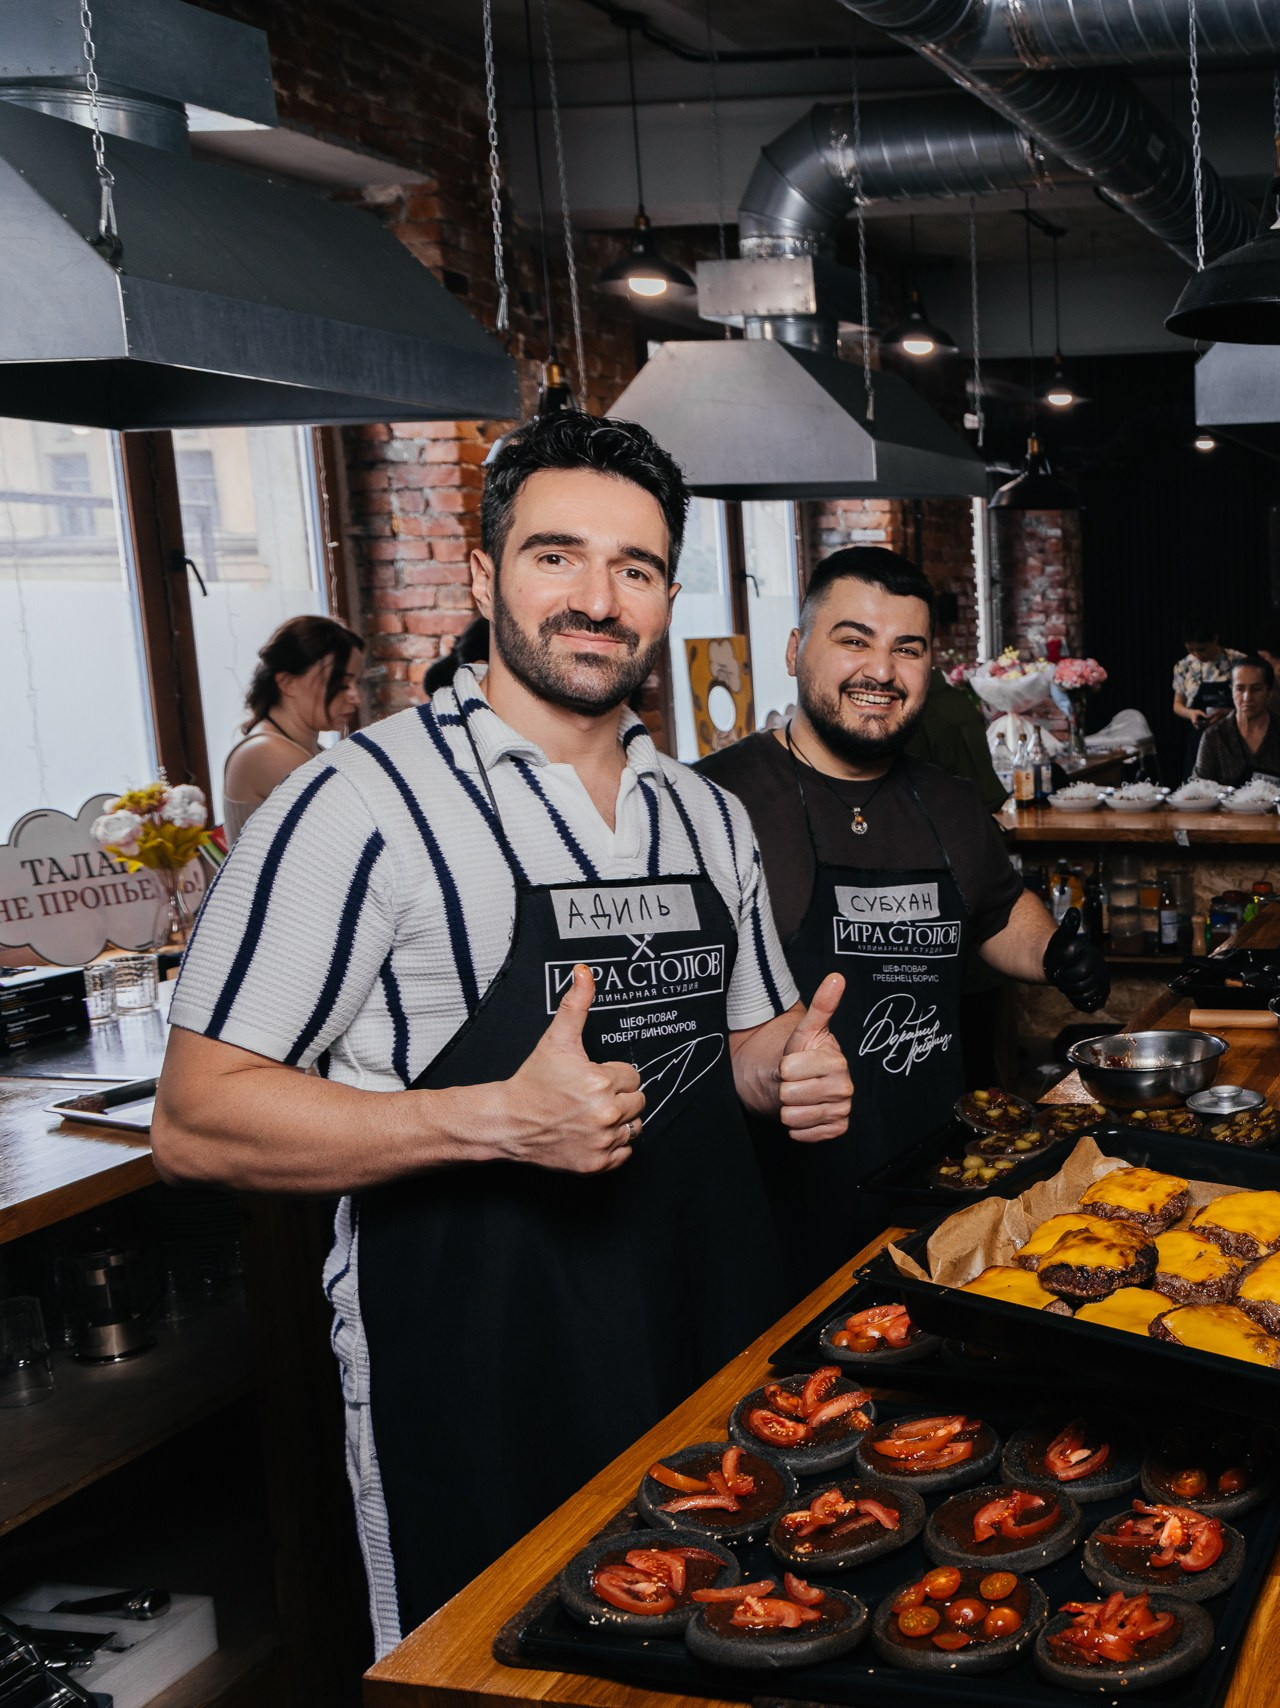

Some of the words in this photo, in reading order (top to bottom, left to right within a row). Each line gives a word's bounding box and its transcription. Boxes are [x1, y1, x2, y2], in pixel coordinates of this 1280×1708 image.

[20, 850, 145, 886] ТАЛА
[0, 896, 34, 922] НЕ
[568, 893, 671, 930] АДИЛЬ
[851, 893, 933, 914] СУБХАН
[839, 922, 885, 943] ИГРА
[888, 925, 958, 945] СТОЛОВ
[554, 965, 624, 994] ИРА
[628, 952, 720, 986] СТОЛОВ
[872, 974, 912, 983] ГРЕБЕНЕЦ
[913, 974, 939, 982] БОРИС
[882, 964, 928, 973] ШЕФ-ПОВАР
[592, 988, 657, 1003] УЛИНАРНАЯ
[662, 982, 699, 995] СТУДИЯ
[620, 1010, 678, 1028] ШЕФ-ПОВАР
[601, 1030, 640, 1044] РОБЕРТ
[640, 1021, 697, 1039] ВИНОКУРОВ
